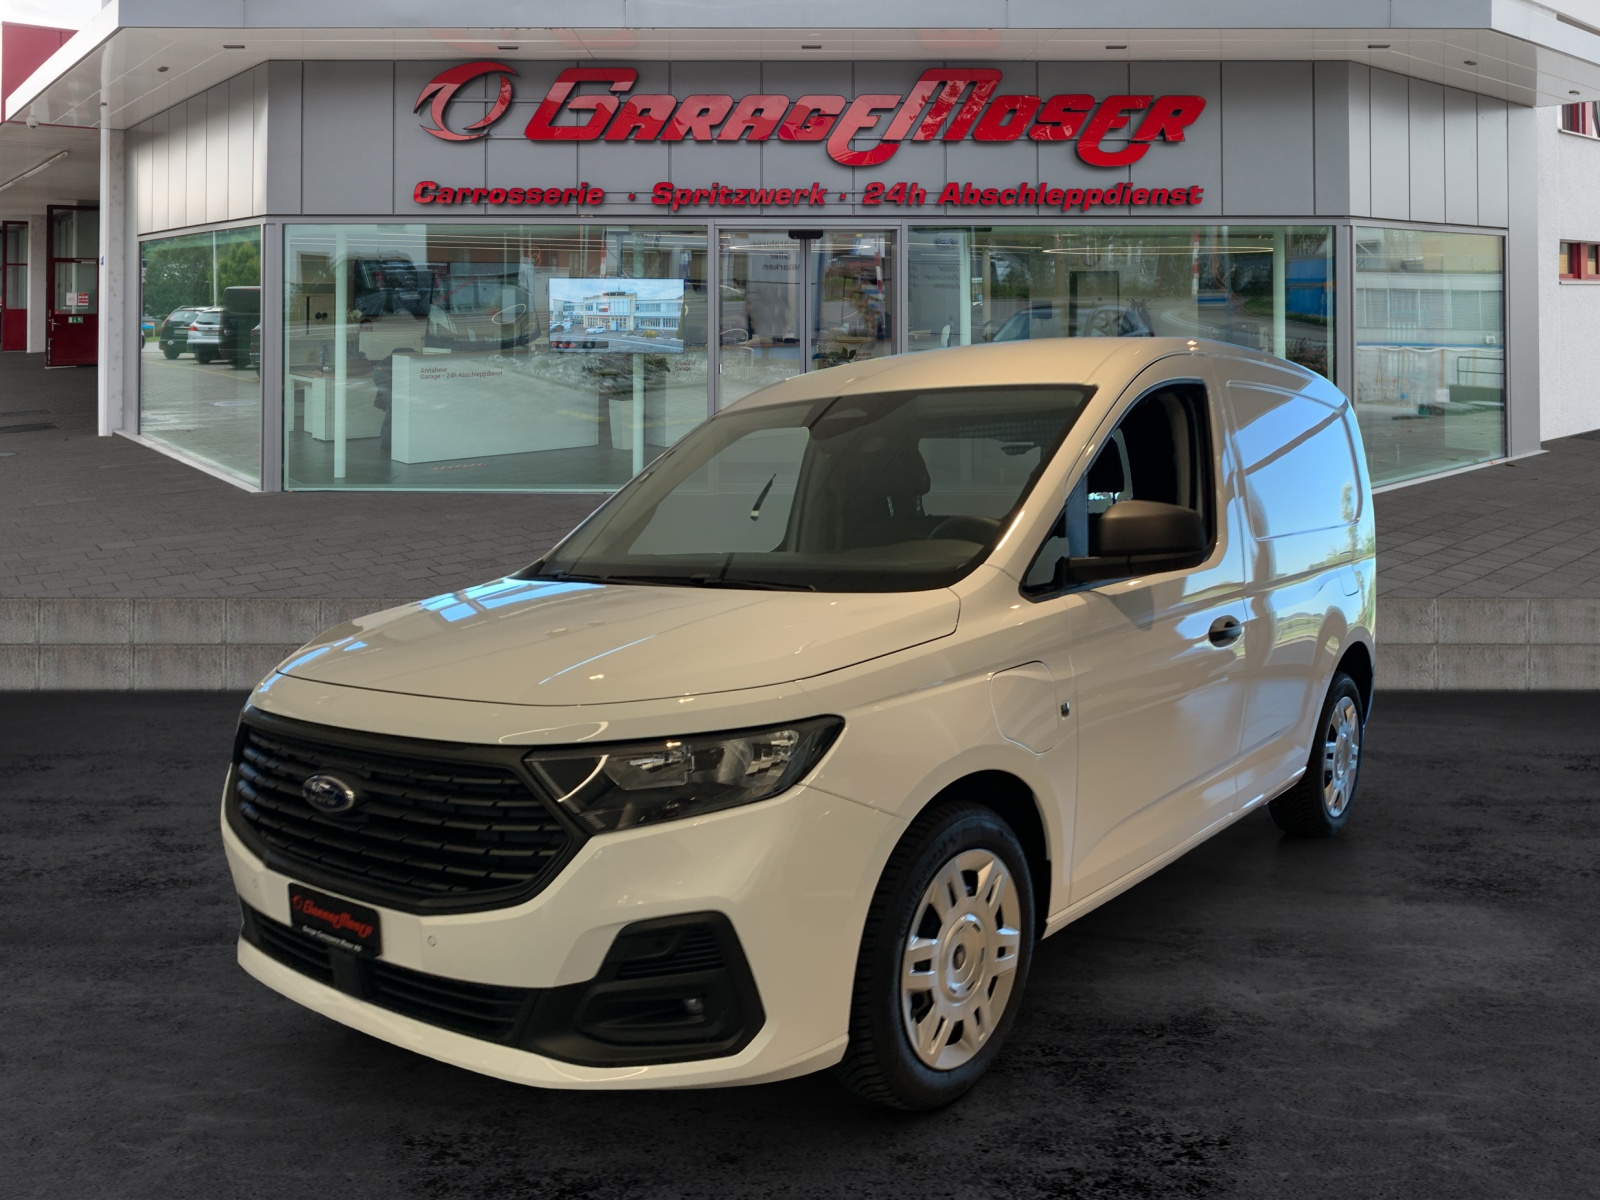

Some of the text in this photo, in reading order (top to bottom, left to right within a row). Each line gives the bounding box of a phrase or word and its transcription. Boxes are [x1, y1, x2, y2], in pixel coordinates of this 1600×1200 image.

[413, 181, 1204, 212] Carrosserie Spritzwerk 24h Abschleppdienst
